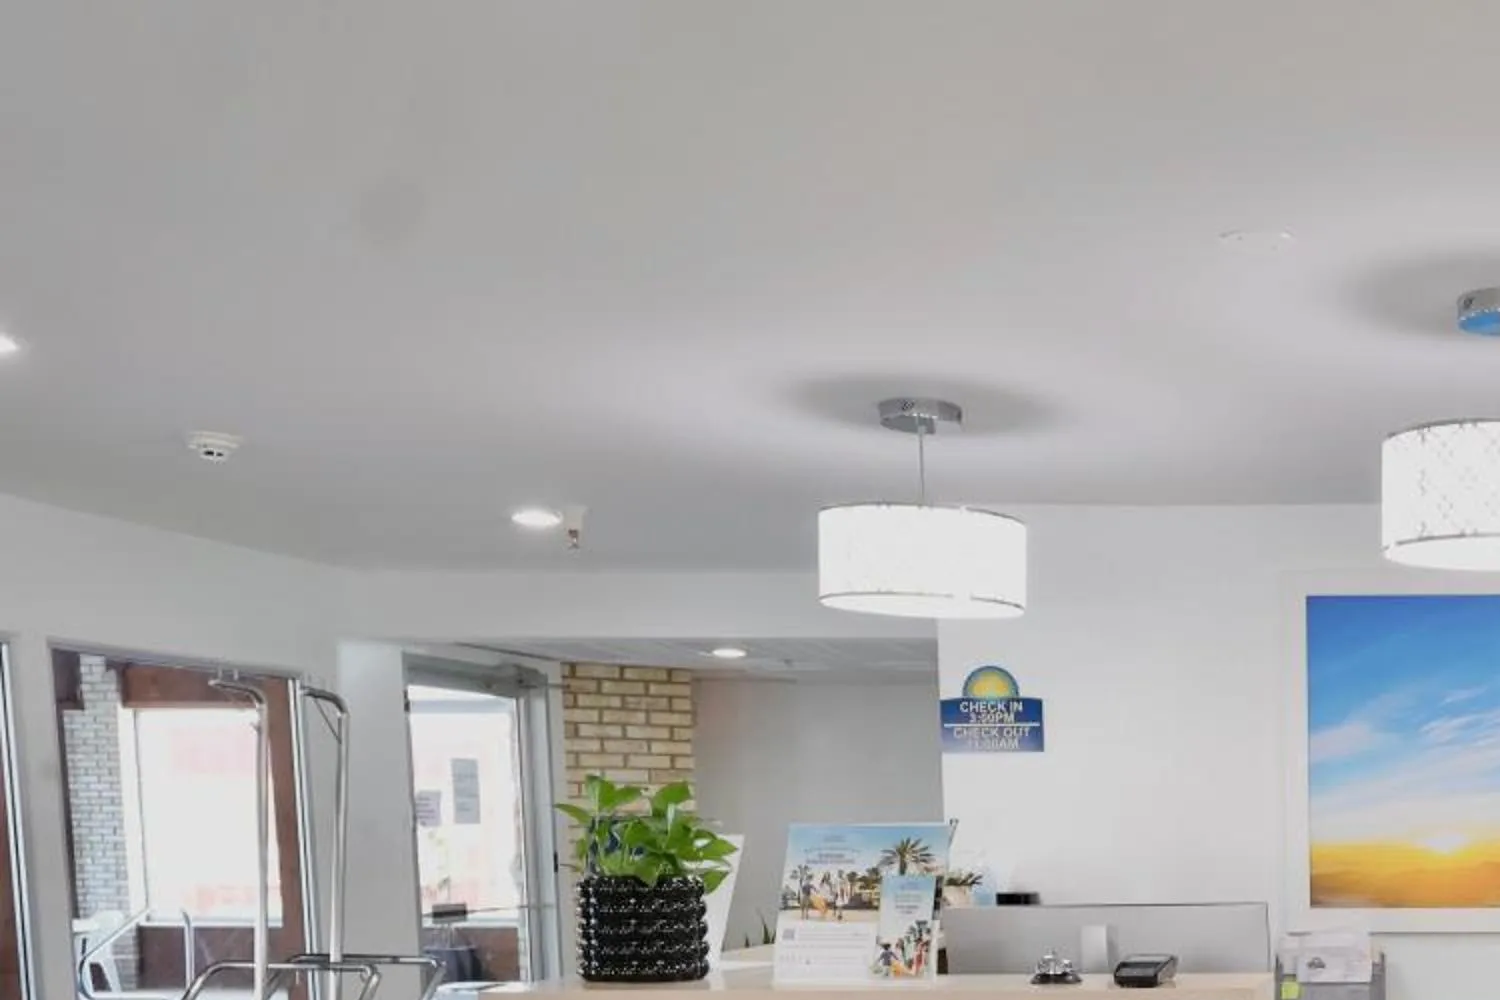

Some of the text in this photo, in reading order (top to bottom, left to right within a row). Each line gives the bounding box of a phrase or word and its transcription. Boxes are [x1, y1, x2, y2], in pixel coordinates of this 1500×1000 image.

[959, 701, 1023, 712] CHECK IN
[953, 726, 1030, 739] CHECK OUT
